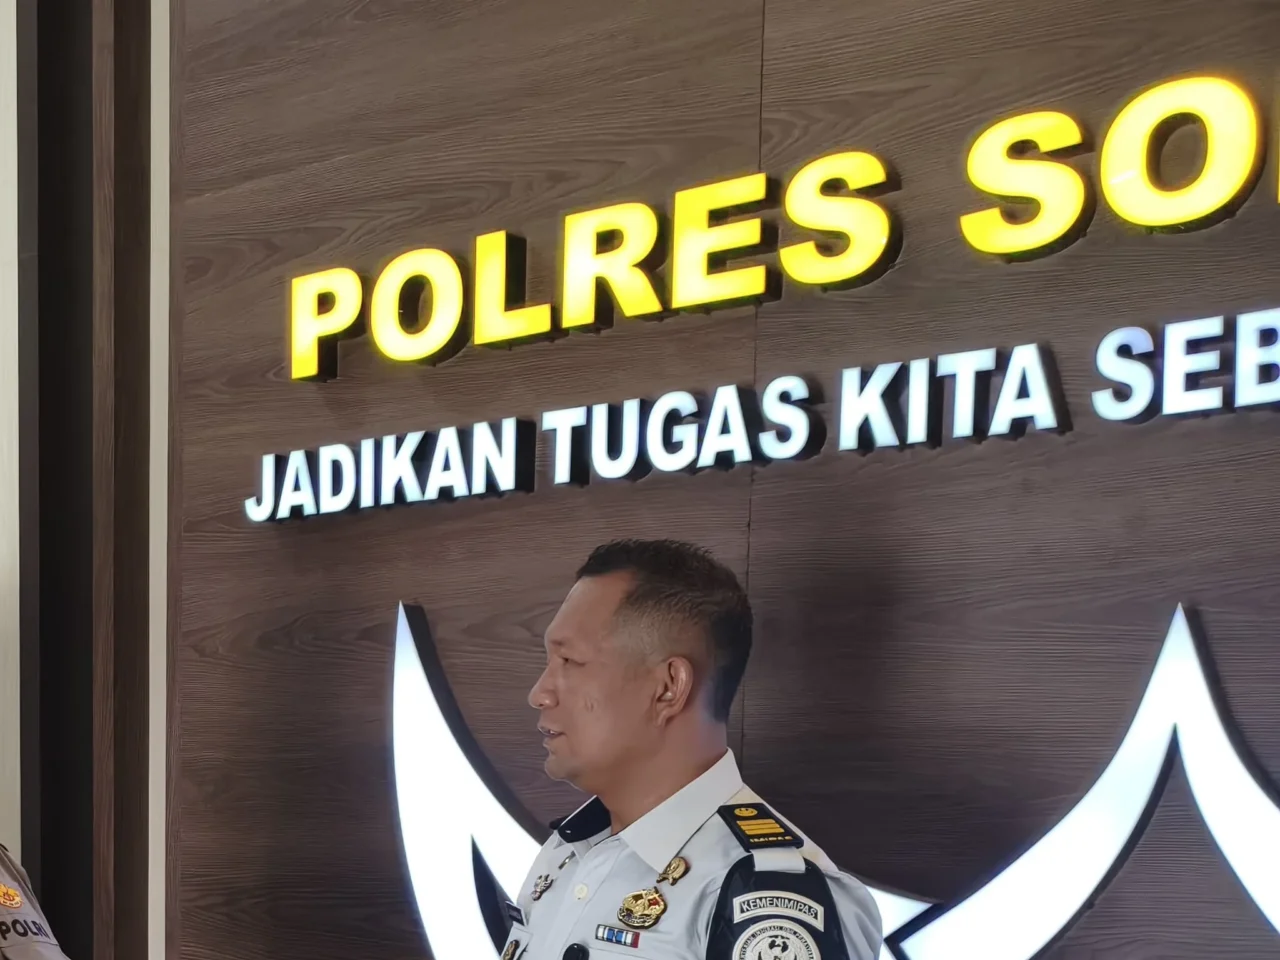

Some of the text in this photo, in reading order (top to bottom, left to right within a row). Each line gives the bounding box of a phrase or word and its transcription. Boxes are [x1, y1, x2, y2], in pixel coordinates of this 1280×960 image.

[290, 75, 1280, 380] POLRES SO
[244, 307, 1280, 522] JADIKAN TUGAS KITA SEB
[741, 897, 818, 918] KEMENIMIPAS
